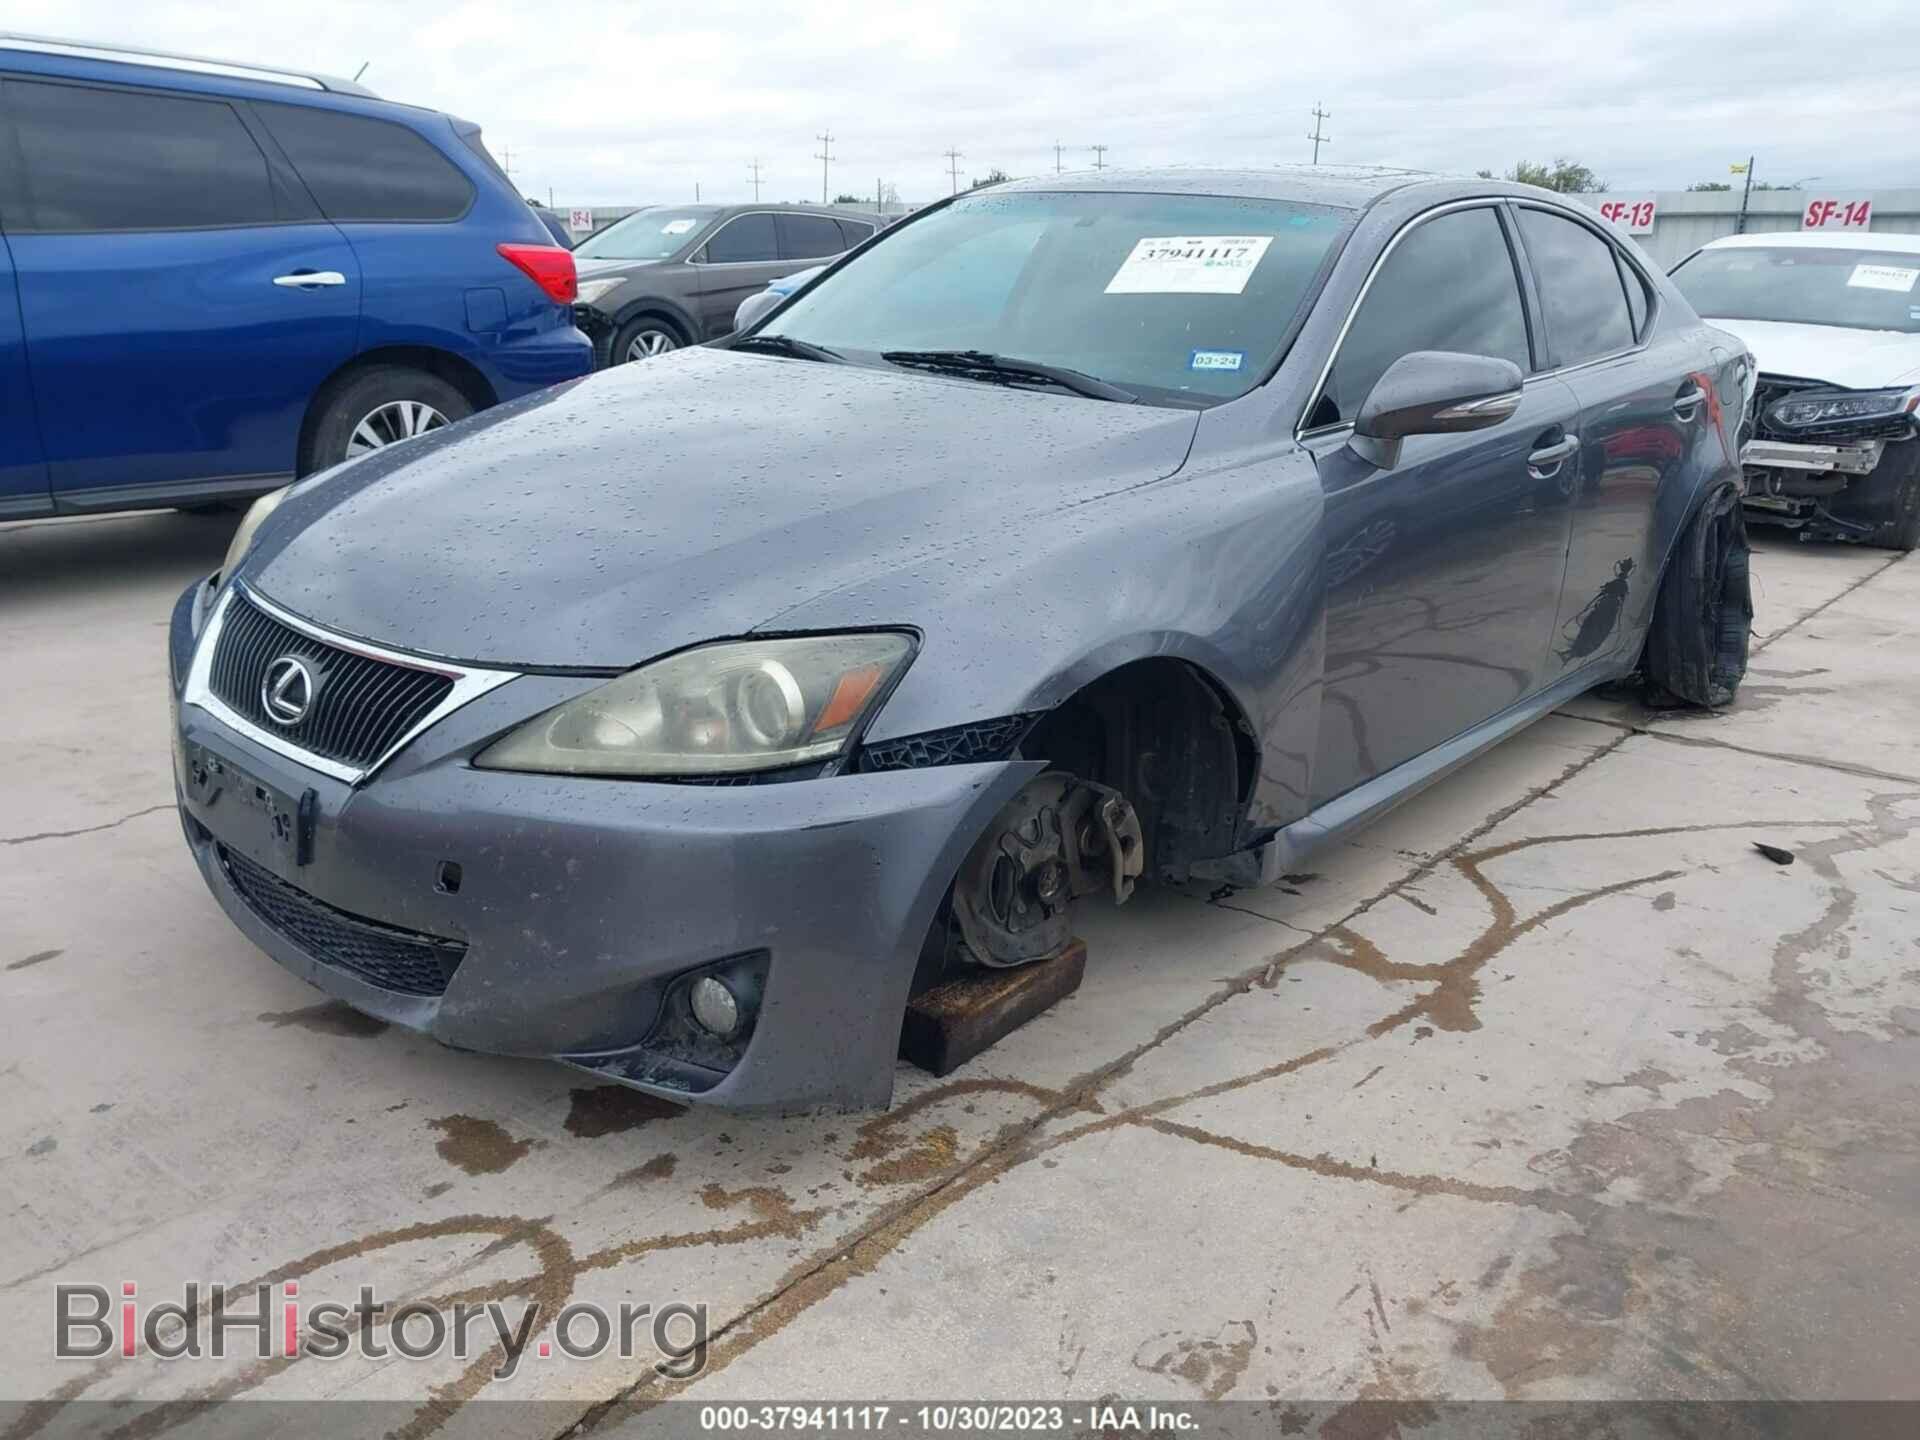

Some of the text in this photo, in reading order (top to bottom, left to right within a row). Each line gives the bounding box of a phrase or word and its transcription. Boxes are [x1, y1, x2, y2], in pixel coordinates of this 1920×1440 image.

[1600, 202, 1654, 226] SF-13
[1805, 201, 1870, 227] SF-14
[1141, 248, 1248, 259] 37941117
